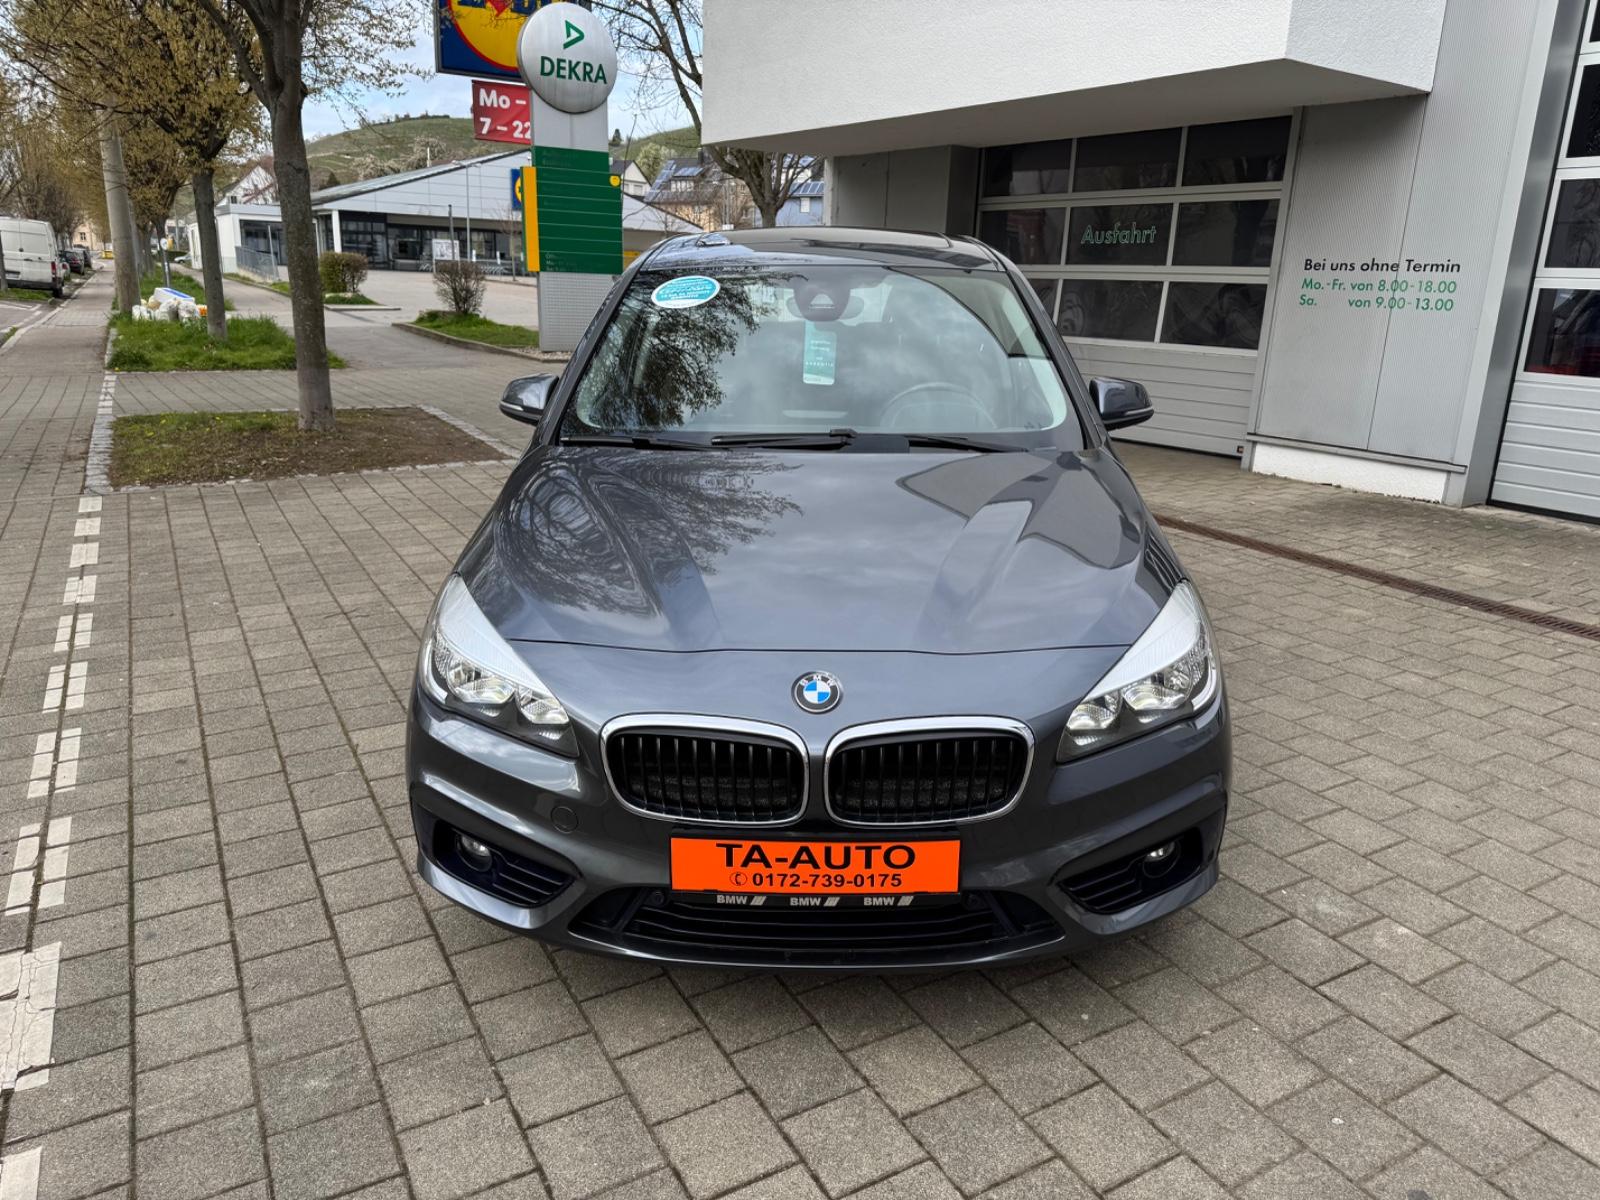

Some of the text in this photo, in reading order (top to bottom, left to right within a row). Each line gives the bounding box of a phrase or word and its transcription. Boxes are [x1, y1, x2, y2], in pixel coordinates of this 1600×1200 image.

[540, 55, 607, 84] DEKRA
[479, 88, 511, 110] Mo
[480, 117, 492, 135] 7
[1081, 222, 1157, 244] Ausfahrt
[1304, 258, 1461, 273] Bei uns ohne Termin
[1350, 282, 1373, 291] von
[1299, 294, 1317, 306] Sa.
[1348, 299, 1371, 308] von
[799, 674, 836, 686] BMW
[716, 843, 916, 870] TA-AUTO
[752, 873, 903, 888] 0172-739-0175
[716, 894, 895, 907] BMW BMW BMW
